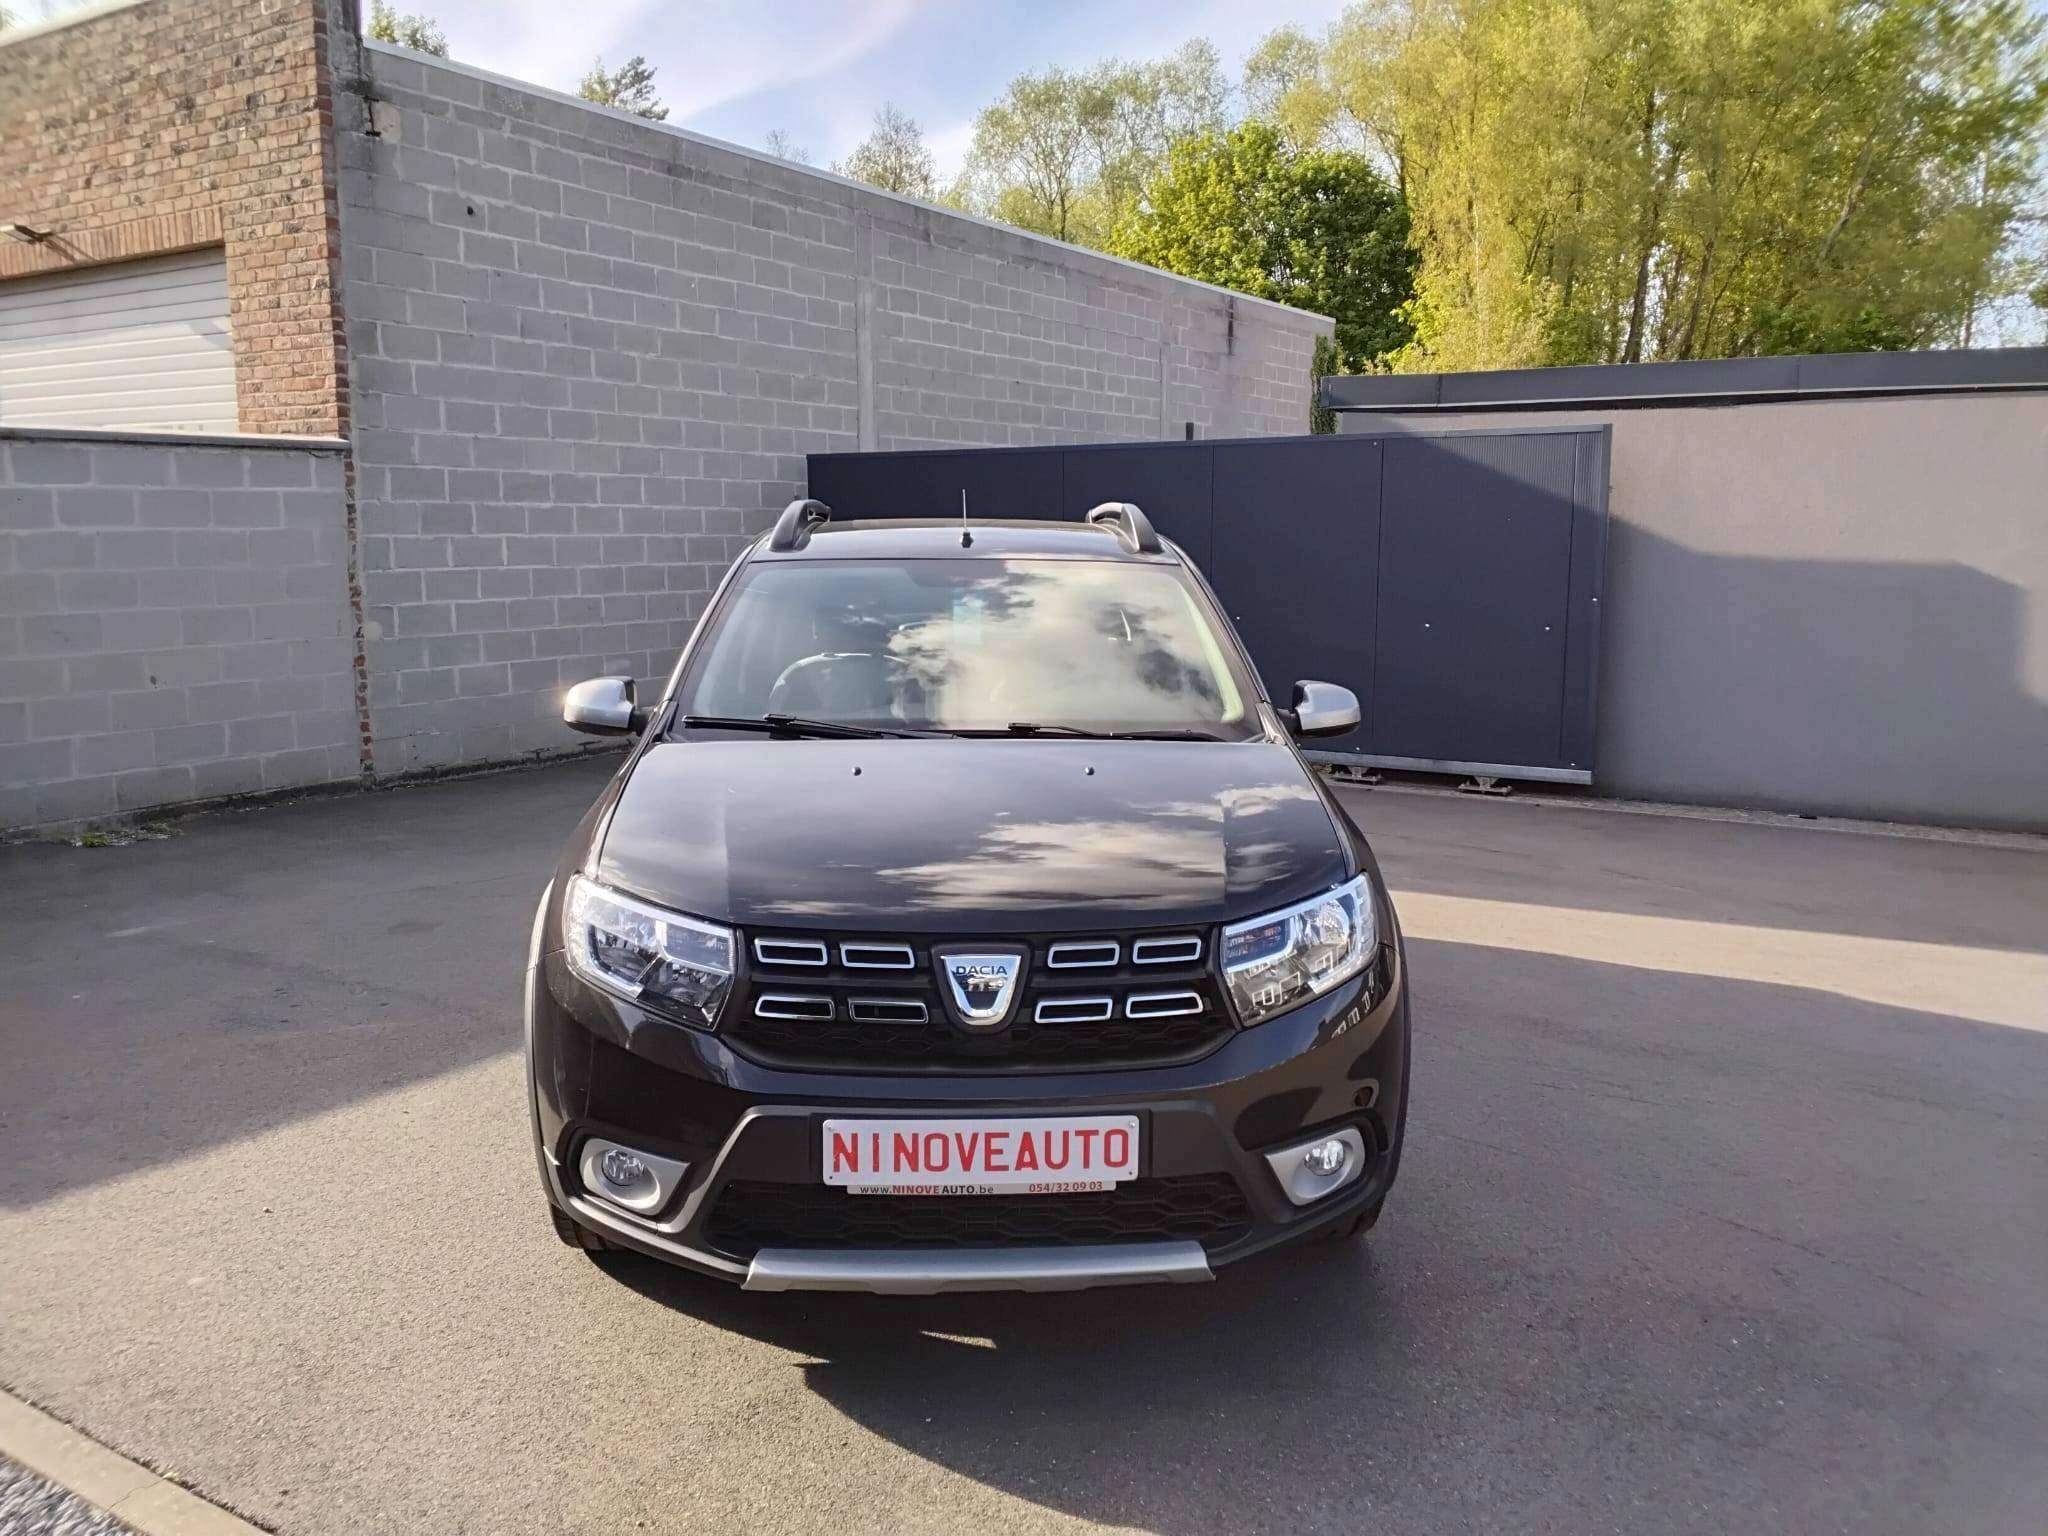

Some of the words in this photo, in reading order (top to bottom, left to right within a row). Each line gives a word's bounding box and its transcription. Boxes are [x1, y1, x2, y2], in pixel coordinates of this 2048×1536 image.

[955, 965, 1008, 975] DACIA
[859, 1184, 994, 1195] www.NINOVEAUTO.be
[1028, 1182, 1070, 1193] 054/32
[1072, 1181, 1087, 1191] 09
[1089, 1181, 1103, 1191] 03
